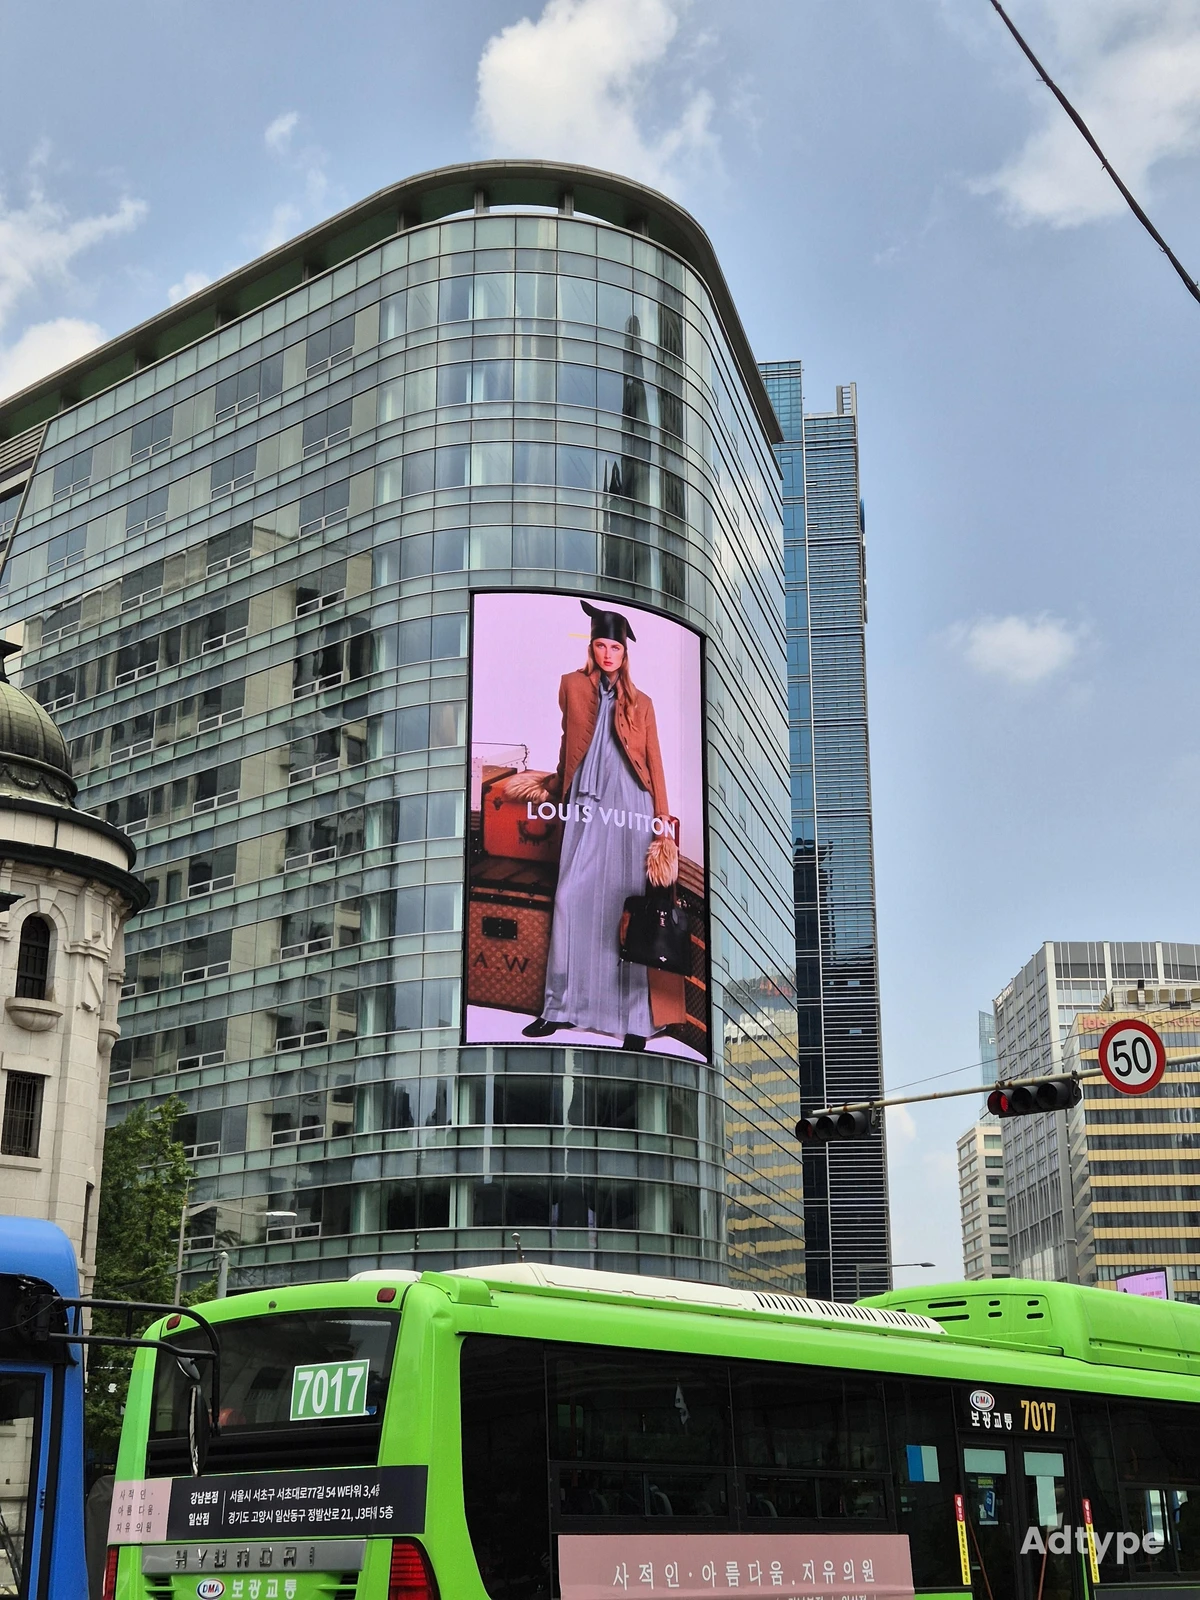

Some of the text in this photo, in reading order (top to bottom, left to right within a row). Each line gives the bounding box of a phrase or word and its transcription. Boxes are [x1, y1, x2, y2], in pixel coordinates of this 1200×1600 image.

[527, 801, 676, 841] LOUIS VUITTON
[1112, 1036, 1152, 1077] 50
[297, 1366, 365, 1415] 7017
[970, 1410, 1013, 1431] 보광교통
[1020, 1399, 1056, 1433] 7017
[190, 1490, 219, 1505] 강남본점
[229, 1488, 252, 1503] 서울시
[253, 1488, 276, 1502] 서초구
[276, 1486, 325, 1502] 서초대로77길
[325, 1486, 337, 1499] 54
[337, 1484, 362, 1499] W타워
[188, 1511, 210, 1526] 일산점
[228, 1510, 250, 1525] 경기도
[251, 1509, 274, 1524] 고양시
[275, 1508, 306, 1523] 일산동구
[307, 1507, 340, 1522] 정발산로
[340, 1508, 354, 1522] 21,
[378, 1505, 394, 1520] 5층
[175, 1546, 315, 1570] HYUNDAI
[802, 1558, 875, 1585] 지유의원
[231, 1578, 298, 1600] 보광교통
